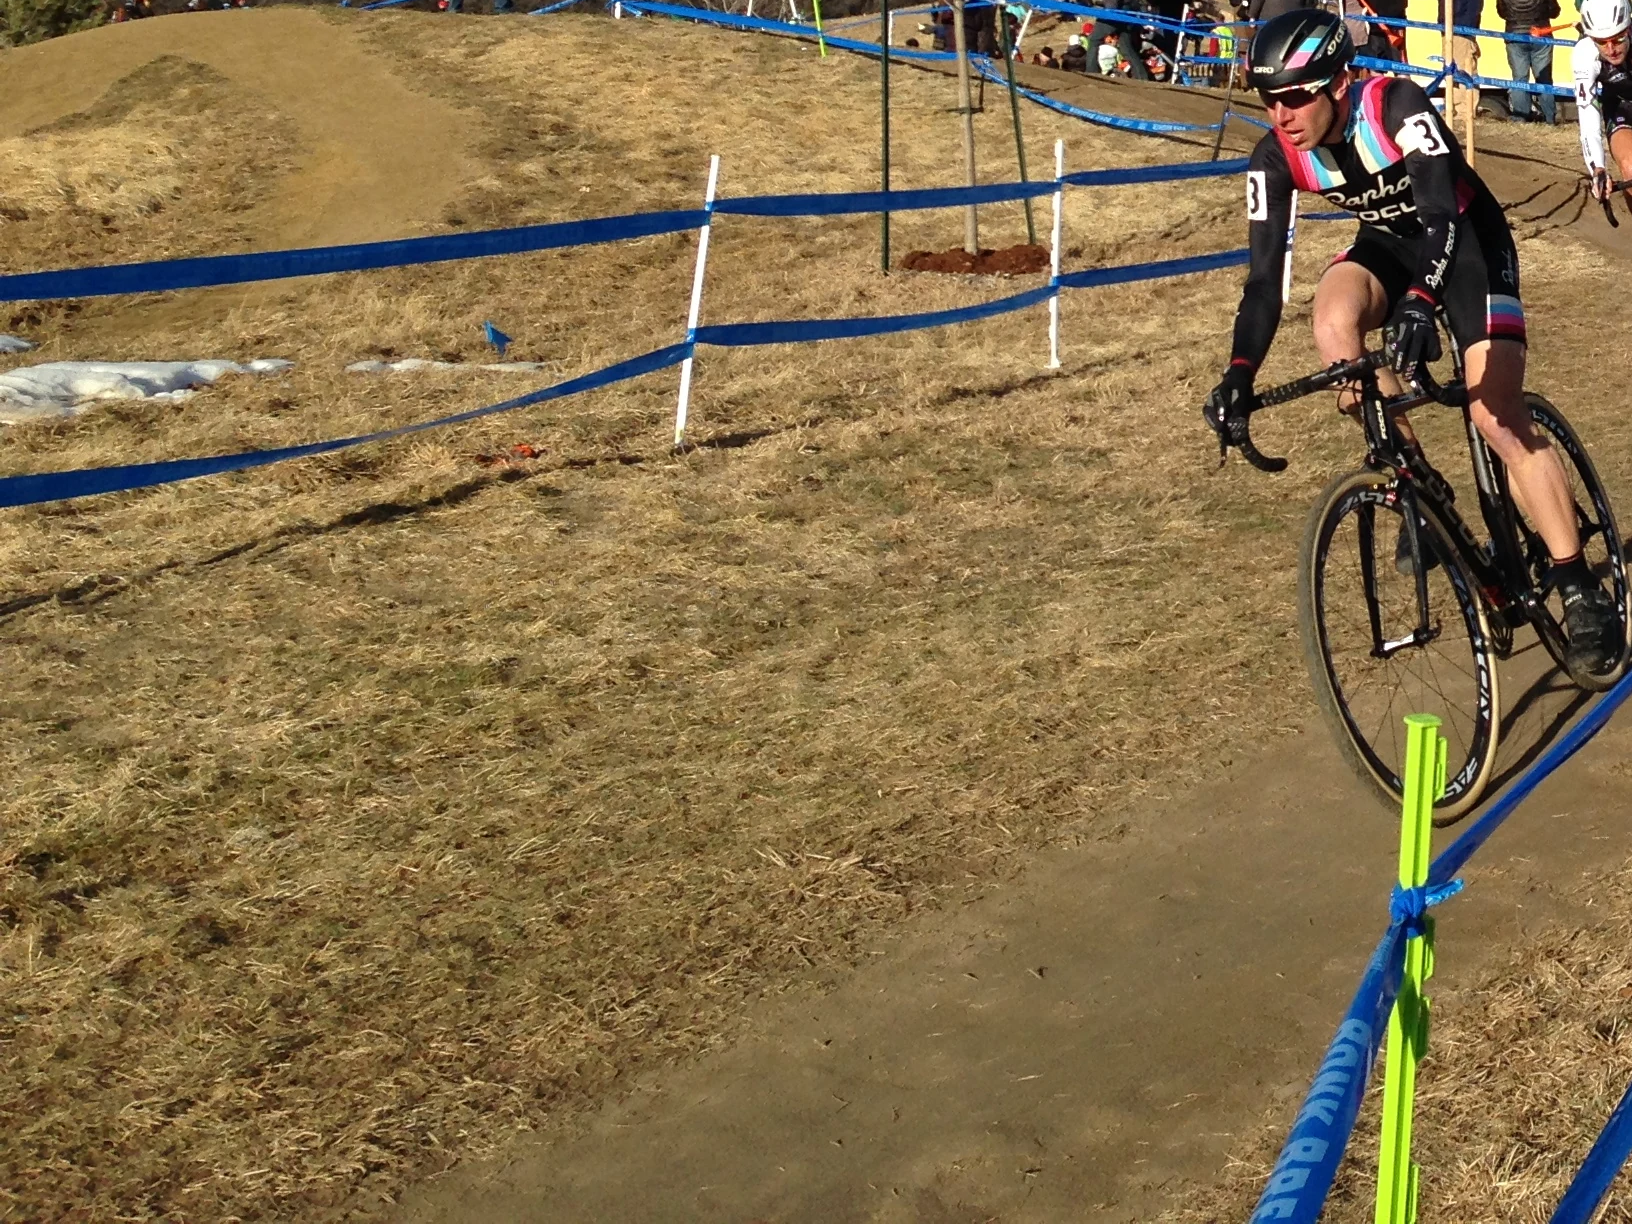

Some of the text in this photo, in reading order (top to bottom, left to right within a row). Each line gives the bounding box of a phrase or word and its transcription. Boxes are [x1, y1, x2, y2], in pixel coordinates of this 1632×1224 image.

[1578, 82, 1588, 102] 4
[1414, 118, 1441, 152] 3
[1248, 175, 1260, 214] 3
[1324, 174, 1412, 209] Rapha
[1358, 202, 1418, 223] OCU
